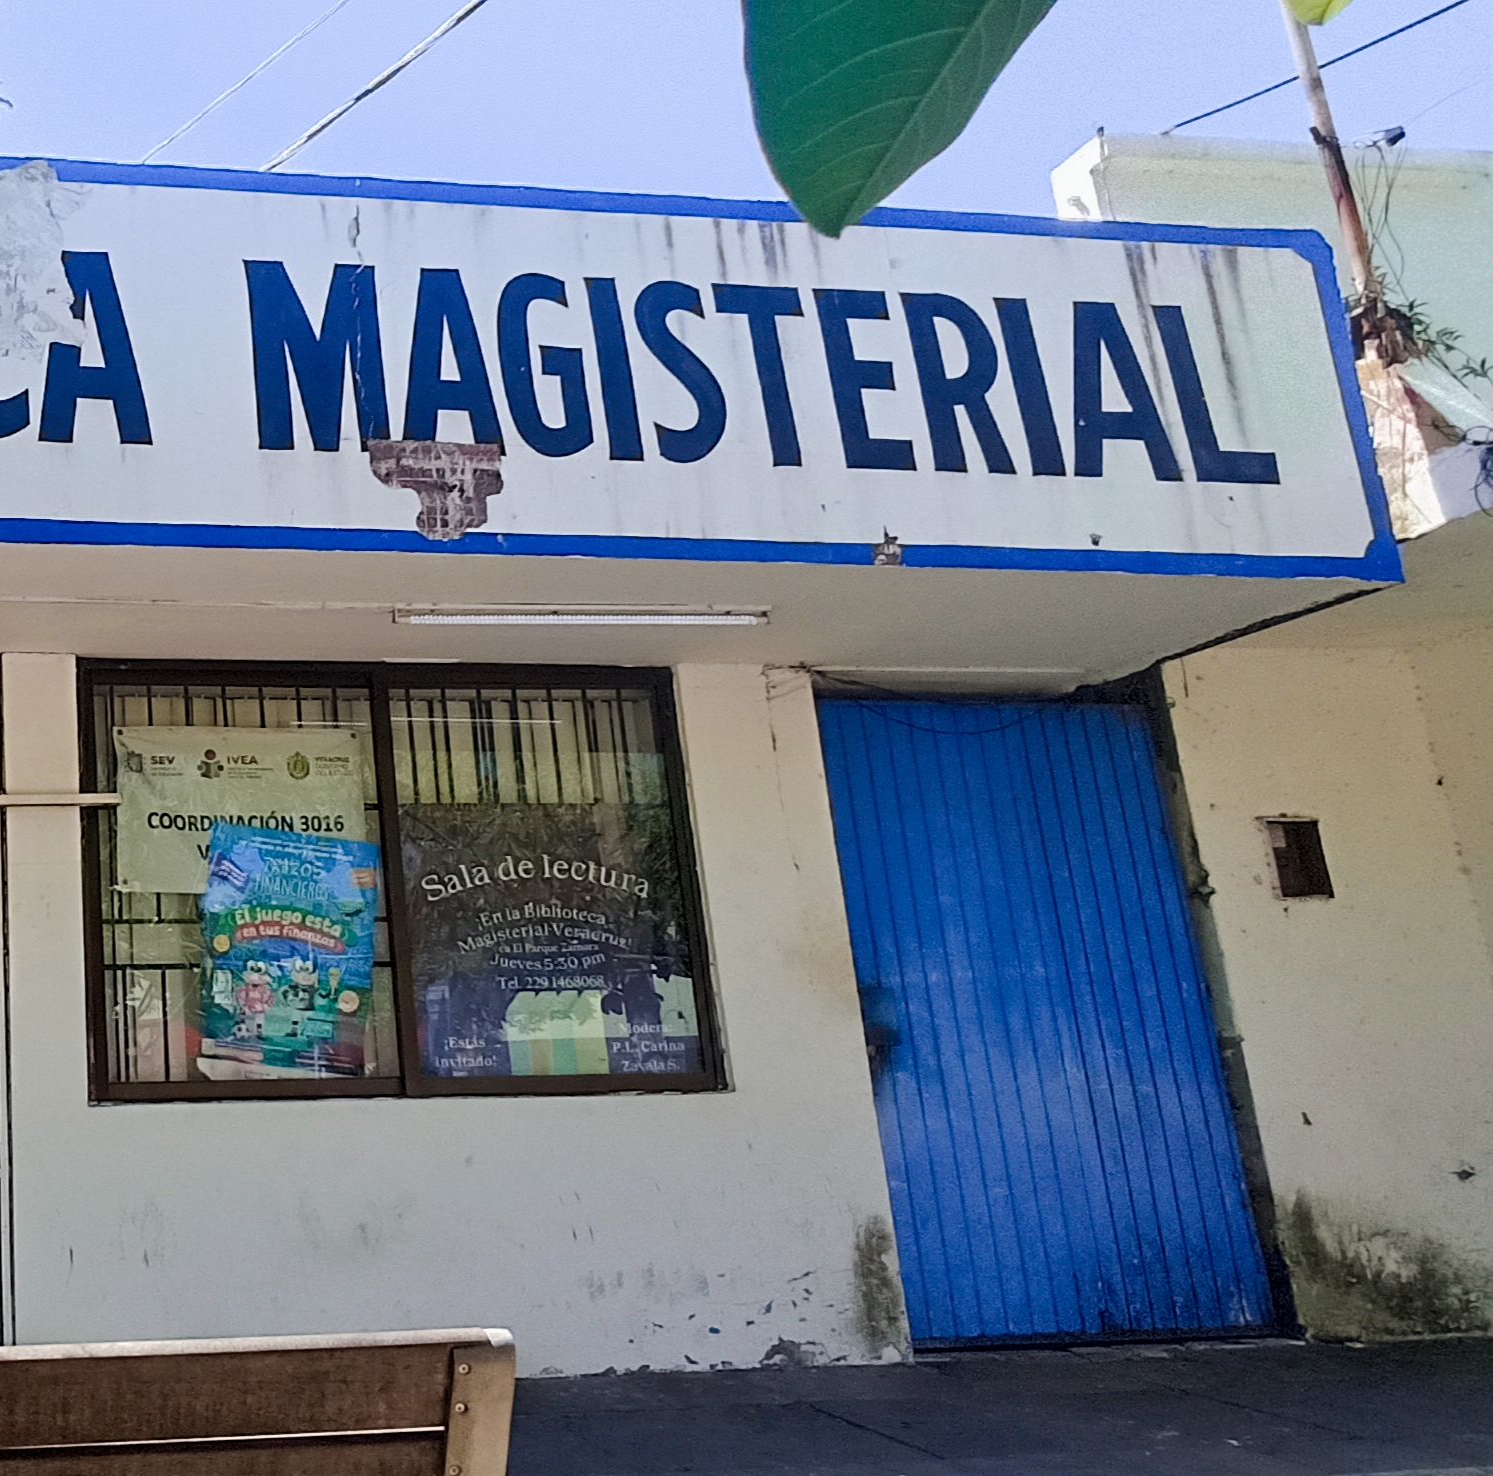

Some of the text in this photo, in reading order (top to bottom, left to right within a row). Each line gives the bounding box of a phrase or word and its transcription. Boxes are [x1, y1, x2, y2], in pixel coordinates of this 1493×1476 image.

[242, 259, 1281, 485] MAGISTERIAL
[150, 756, 175, 765] SEV
[227, 755, 259, 765] IVEA
[300, 815, 344, 832] 3016
[421, 853, 650, 901] Sala de lectura
[235, 904, 251, 926] El
[253, 906, 303, 926] juego
[476, 903, 607, 931] ¡En la Biblioteca
[242, 924, 337, 948] en tus finanzas
[525, 943, 559, 955] Parque
[489, 953, 543, 970] Jueves
[543, 957, 578, 971] 5:30
[640, 1040, 685, 1053] Carina
[435, 1053, 497, 1068] invitado!
